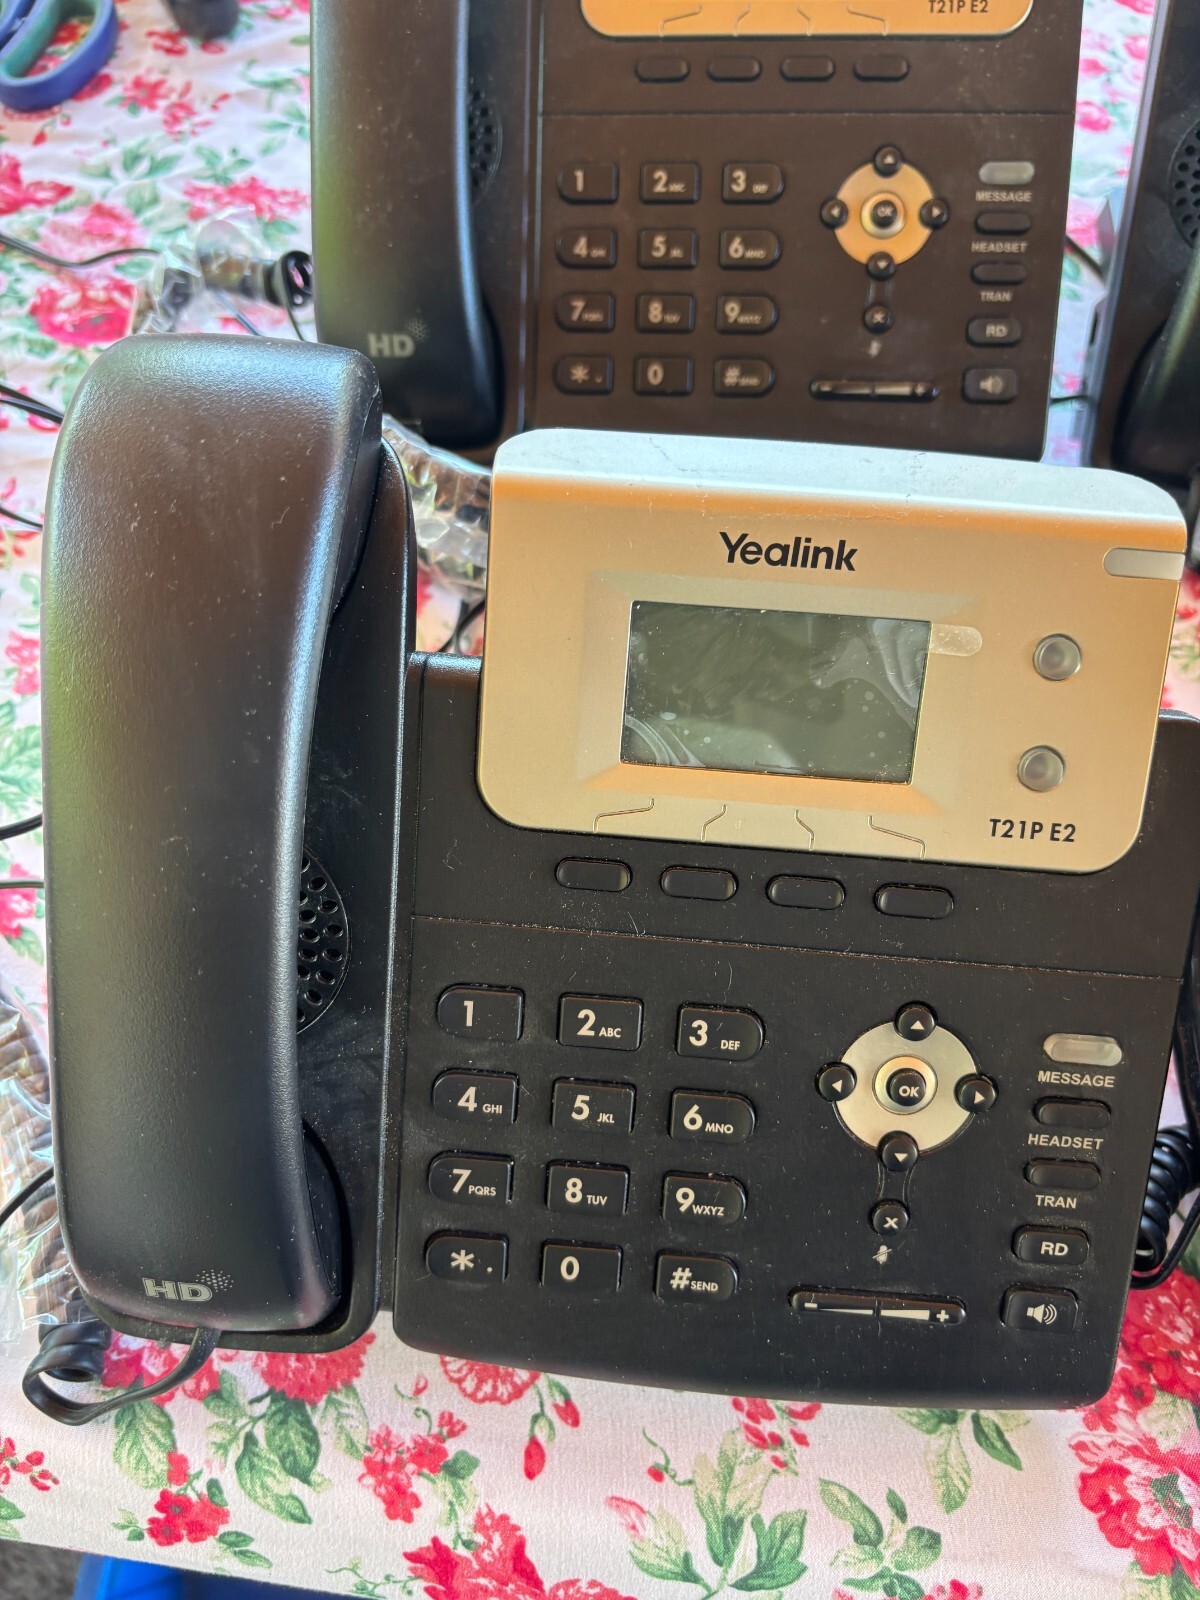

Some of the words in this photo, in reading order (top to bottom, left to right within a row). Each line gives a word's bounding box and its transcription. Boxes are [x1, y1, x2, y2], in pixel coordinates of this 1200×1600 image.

[928, 0, 966, 14] T21P
[970, 0, 988, 14] E2
[573, 169, 585, 192] 1
[652, 170, 669, 193] 2
[731, 169, 747, 193] 3
[975, 190, 1032, 203] MESSAGE
[573, 235, 588, 258] 4
[651, 235, 667, 258] 5
[728, 236, 744, 259] 6
[971, 241, 1028, 253] HEADSET
[570, 299, 586, 322] 7
[648, 301, 664, 324] 8
[724, 301, 741, 324] 9
[985, 324, 1008, 338] RD
[368, 332, 416, 358] HD
[647, 363, 664, 386] 0
[719, 531, 859, 572] Yealink
[989, 818, 1044, 840] T21P
[1049, 822, 1076, 843] E2
[463, 1000, 474, 1027] 1
[576, 1009, 596, 1037] 2
[598, 1026, 622, 1039] ABC
[688, 1019, 708, 1047] 3
[720, 1038, 741, 1052] DEF
[1037, 1070, 1115, 1089] MESSAGE
[457, 1086, 478, 1112] 4
[482, 1103, 503, 1114] GHI
[898, 1085, 920, 1098] OK
[571, 1094, 591, 1120] 5
[597, 1112, 615, 1124] JKL
[683, 1104, 703, 1131] 6
[705, 1121, 734, 1134] MNO
[1027, 1133, 1104, 1150] HEADSET
[451, 1168, 472, 1194] 7
[468, 1184, 497, 1197] PQRS
[564, 1177, 584, 1203] 8
[586, 1194, 608, 1206] TUV
[675, 1187, 695, 1212] 9
[692, 1203, 725, 1217] WXYZ
[1035, 1194, 1077, 1209] TRAN
[1040, 1241, 1069, 1257] RD
[560, 1256, 580, 1281] 0
[142, 1277, 213, 1302] HD
[690, 1280, 719, 1292] SEND
